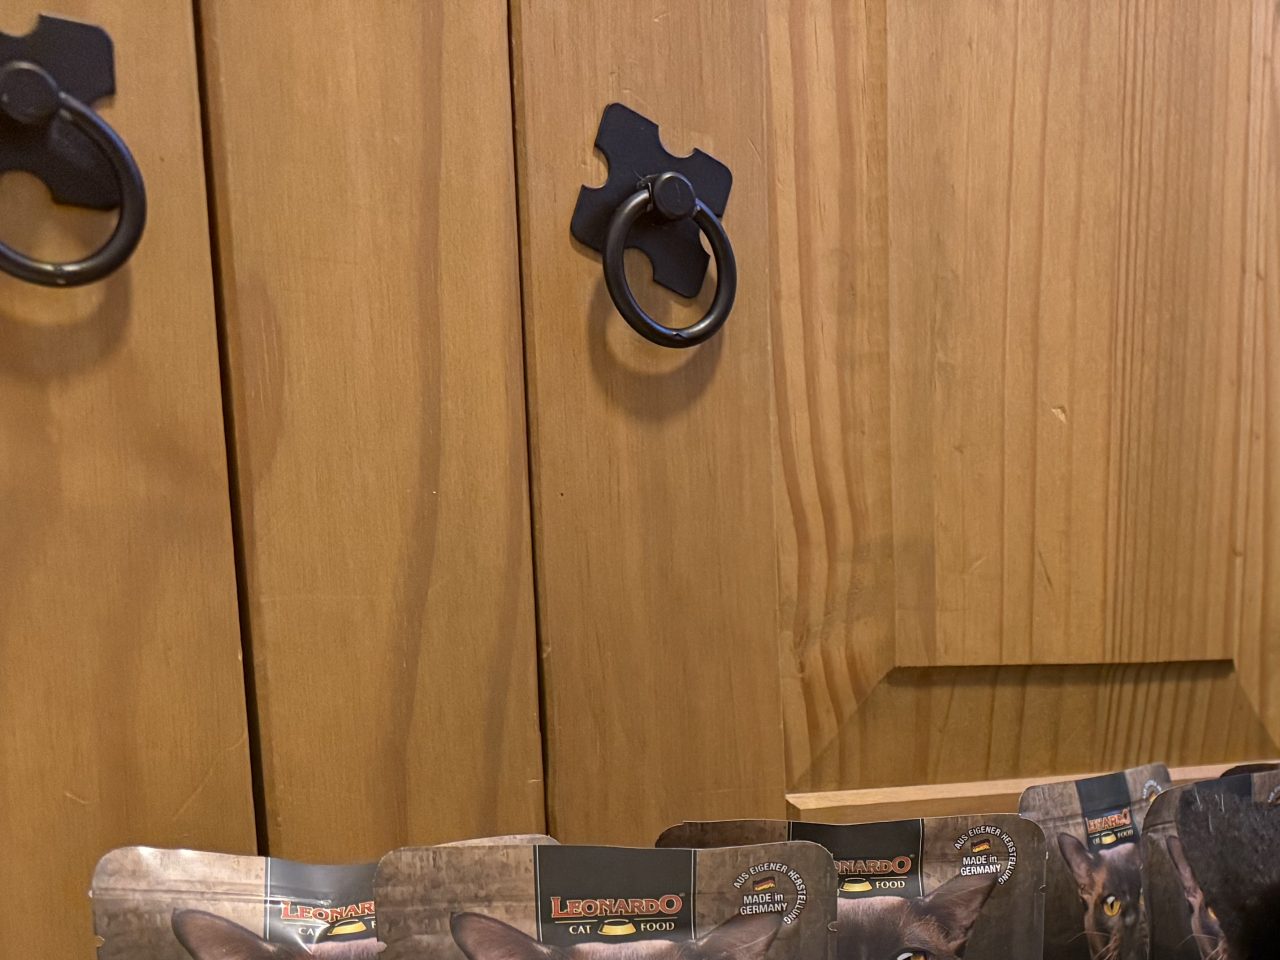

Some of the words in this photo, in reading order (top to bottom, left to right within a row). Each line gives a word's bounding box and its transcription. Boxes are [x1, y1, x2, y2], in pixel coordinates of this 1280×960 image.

[954, 835, 968, 849] AUS
[968, 826, 1001, 836] EIGENER
[998, 833, 1017, 885] HERSTELLUNG
[963, 855, 987, 865] MADE
[989, 854, 997, 863] in
[960, 864, 1001, 876] GERMANY
[876, 881, 906, 889] FOOD
[733, 872, 749, 889] AUS
[749, 863, 788, 875] EIGENER
[783, 869, 807, 924] HERSTELLUNG
[743, 893, 772, 904] MADE
[774, 892, 784, 902] in
[550, 894, 683, 918] LEONARDO
[740, 902, 788, 915] GERMANY
[569, 925, 592, 935] CAT
[640, 922, 675, 932] FOOD
